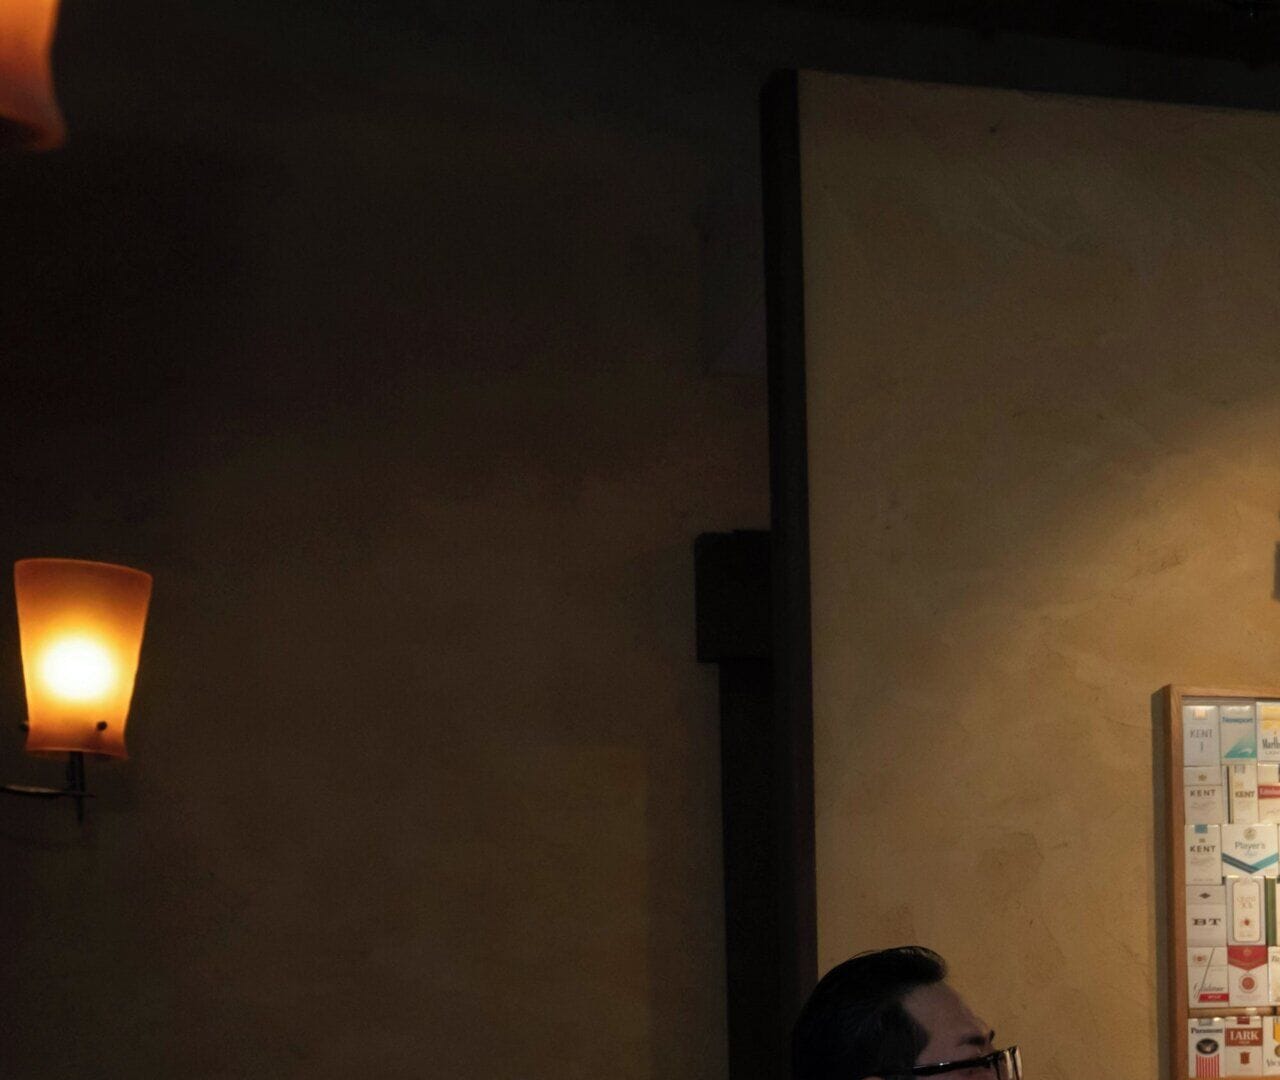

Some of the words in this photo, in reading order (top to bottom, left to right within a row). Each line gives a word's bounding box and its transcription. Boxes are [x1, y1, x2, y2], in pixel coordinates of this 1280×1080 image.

[1189, 728, 1213, 738] KENT
[1189, 789, 1216, 797] KENT
[1234, 790, 1255, 798] KENT
[1189, 845, 1216, 853] KENT
[1230, 1030, 1259, 1041] LARK
